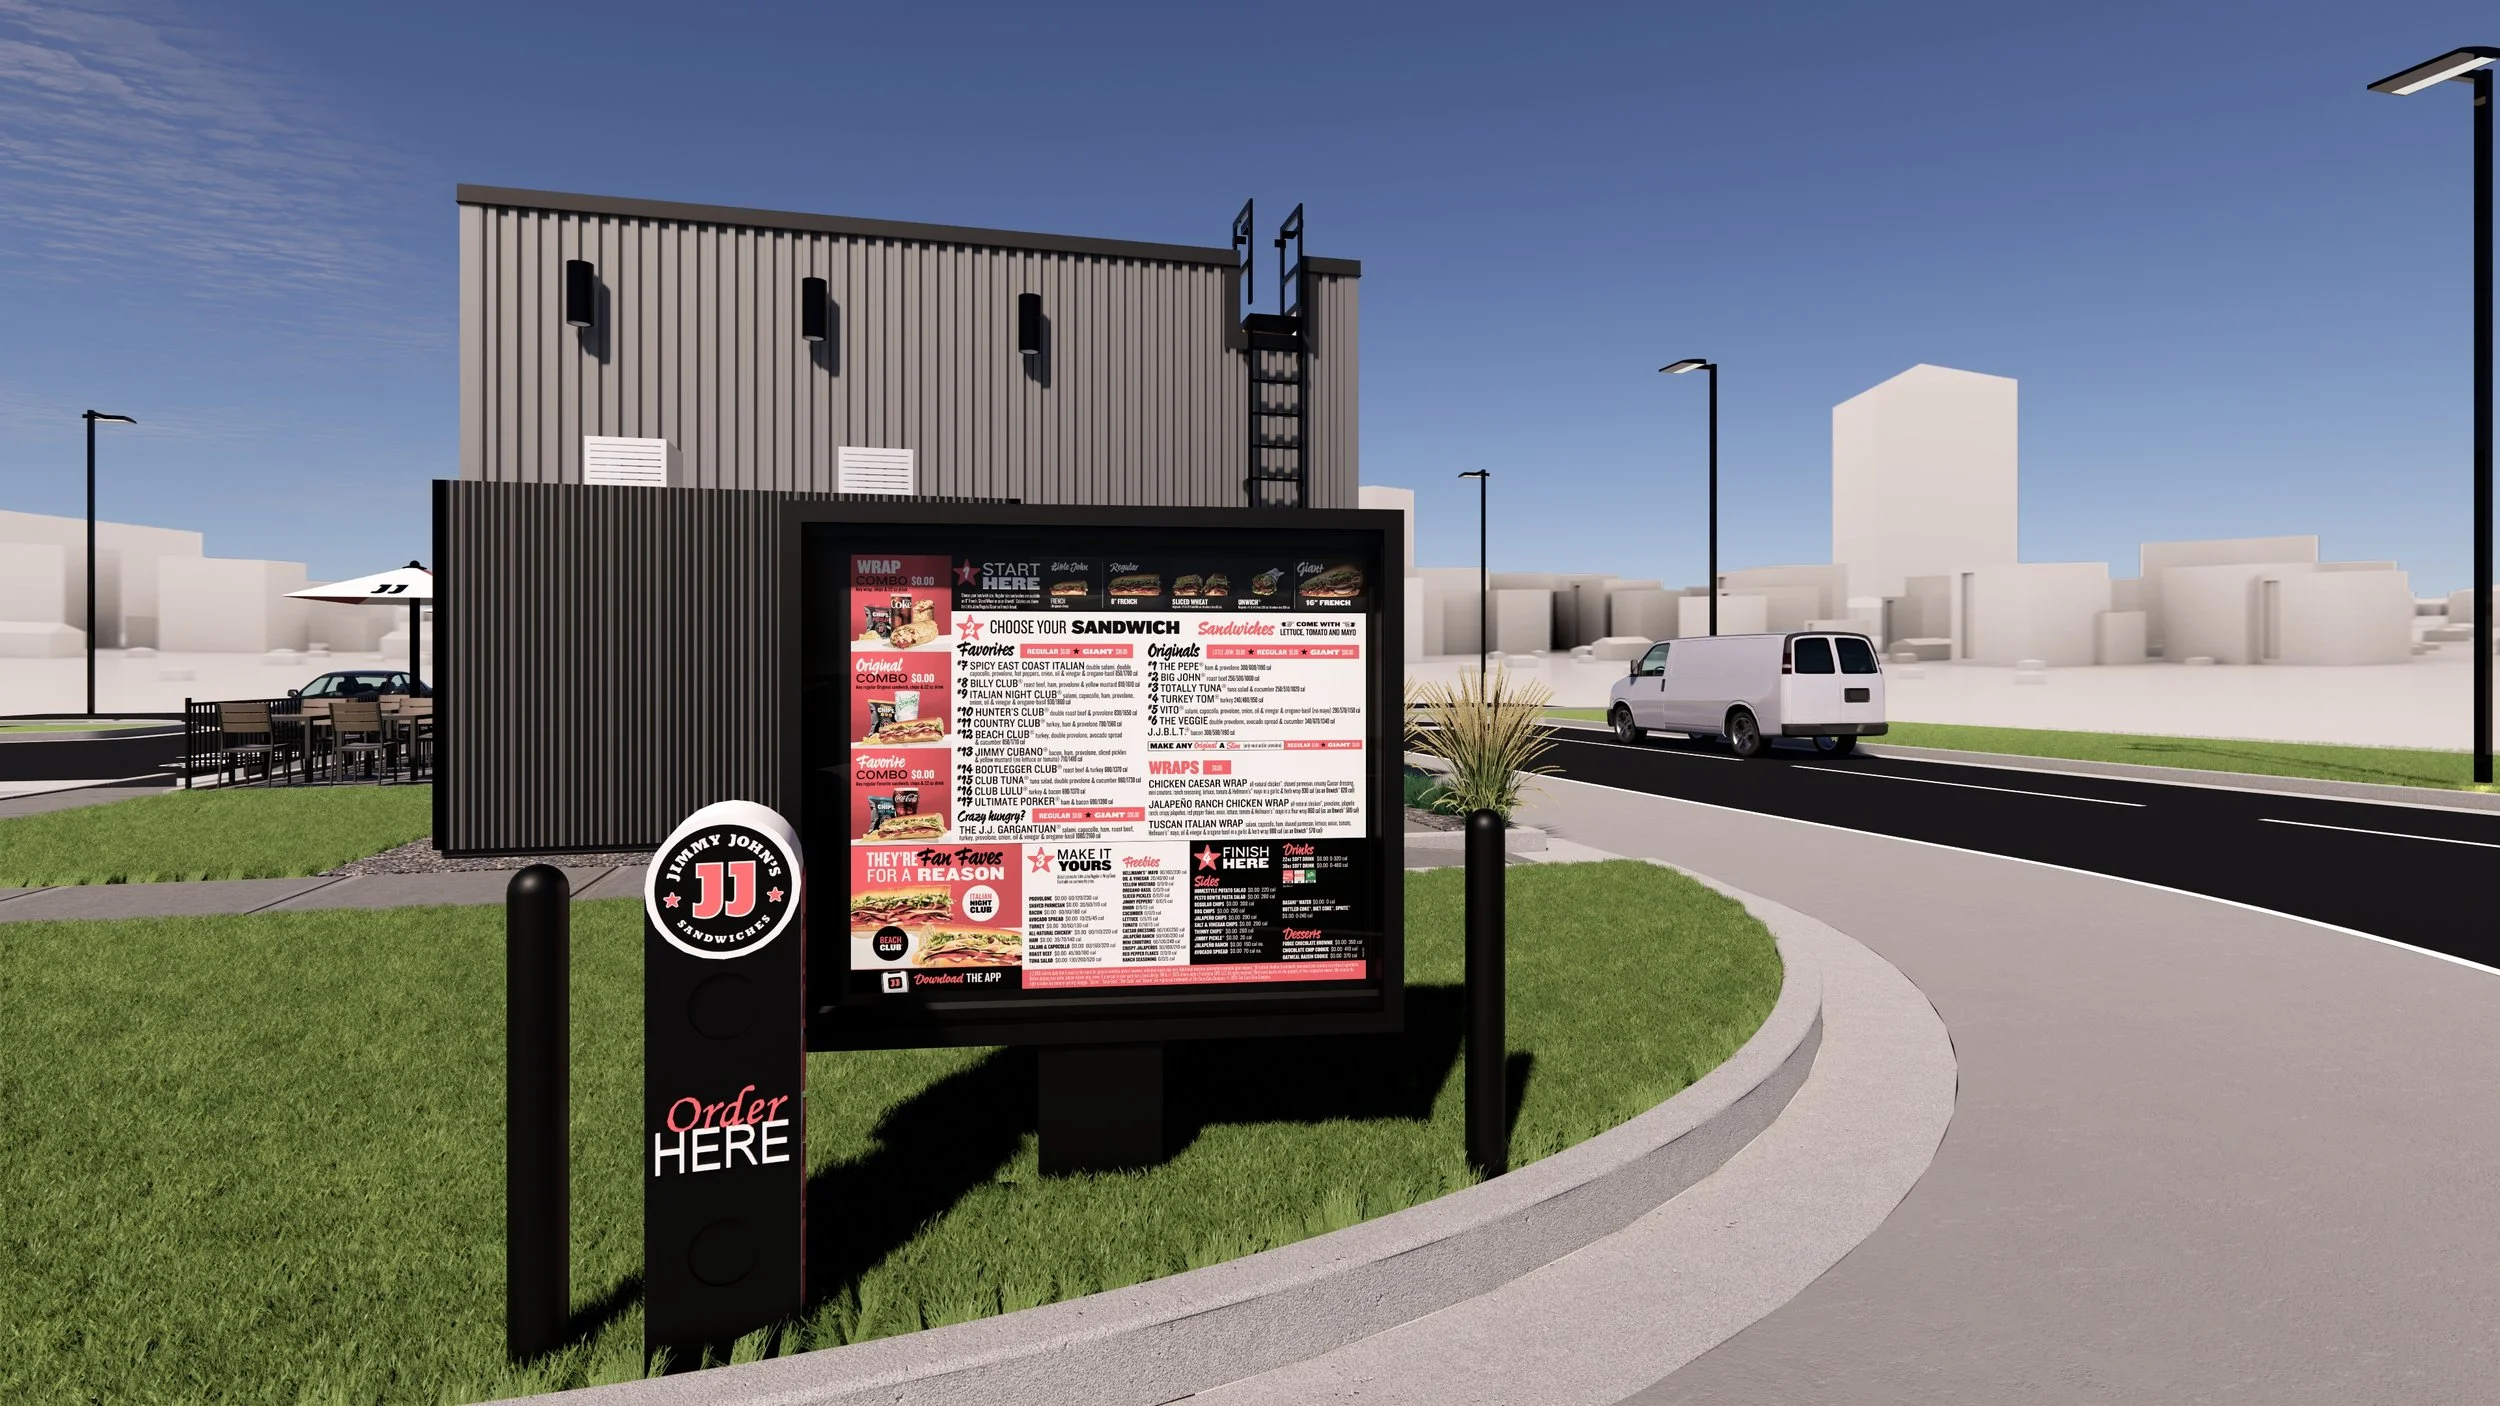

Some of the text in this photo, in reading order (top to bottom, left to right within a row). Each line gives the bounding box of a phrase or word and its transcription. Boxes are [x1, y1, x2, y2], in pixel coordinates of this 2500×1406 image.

[857, 560, 901, 573] WRAP
[983, 563, 1040, 575] START
[1070, 563, 1088, 572] John
[1110, 563, 1139, 573] Regular
[1297, 562, 1324, 576] Giant
[856, 576, 934, 585] COMBO $0.00
[982, 577, 1040, 590] HERE
[966, 620, 1179, 634] 2 CHOOSE YOUR SANDWICH
[1198, 621, 1275, 636] Sandwiches
[957, 643, 1014, 656] Favorites
[1148, 643, 1200, 660] Originals
[856, 658, 903, 675] Original
[970, 662, 995, 670] SPICY
[998, 662, 1019, 670] EAST
[1022, 662, 1049, 670] COAST
[1052, 662, 1084, 670] ITALIAN
[856, 673, 934, 683] COMBO $0.00
[1161, 673, 1174, 681] BIG
[1161, 684, 1197, 692] TOTALLY
[1161, 695, 1194, 703] TURKEY
[975, 708, 1018, 716] HUNTER'S
[974, 719, 1015, 727] COUNTRY
[1160, 717, 1176, 725] THE
[1179, 717, 1208, 725] VEGGIE
[1194, 741, 1217, 750] Original
[975, 748, 1005, 756] JIMMY
[856, 755, 905, 769] Favorite
[1149, 761, 1199, 774] WRAPS
[856, 770, 934, 779] COMBO $0.00
[1149, 779, 1247, 788] CHICKEN CAESAR WRAP
[975, 787, 998, 795] CLUB
[975, 798, 1018, 806] ULTIMATE
[1149, 798, 1289, 808] JALAPEÑO RANCH CHICKEN WRAP
[958, 810, 1026, 824] Crazy hungry?
[1149, 819, 1243, 828] TUSCAN ITALIAN WRAP
[960, 826, 976, 834] THE
[1058, 849, 1111, 860] MAKE IT
[1223, 847, 1269, 857] FINISH
[1282, 843, 1314, 855] Drinks
[666, 834, 782, 882] JIMMY JOHN'S
[867, 848, 1003, 867] THEY'RE Fan Faves
[1036, 854, 1044, 866] 3
[1122, 856, 1160, 868] Freebies
[1203, 852, 1211, 864] 4
[1223, 858, 1269, 869] HERE
[1058, 860, 1111, 871] YOURS
[867, 867, 1004, 883] FOR A REASON
[1194, 875, 1220, 887] Sides
[692, 860, 756, 919] JJ
[677, 914, 771, 943] SANDWICHES
[1282, 928, 1321, 940] Desserts
[880, 936, 901, 944] BEACH
[914, 973, 1001, 985] Download THE APP
[667, 1085, 788, 1132] Order
[655, 1119, 790, 1177] HERE
